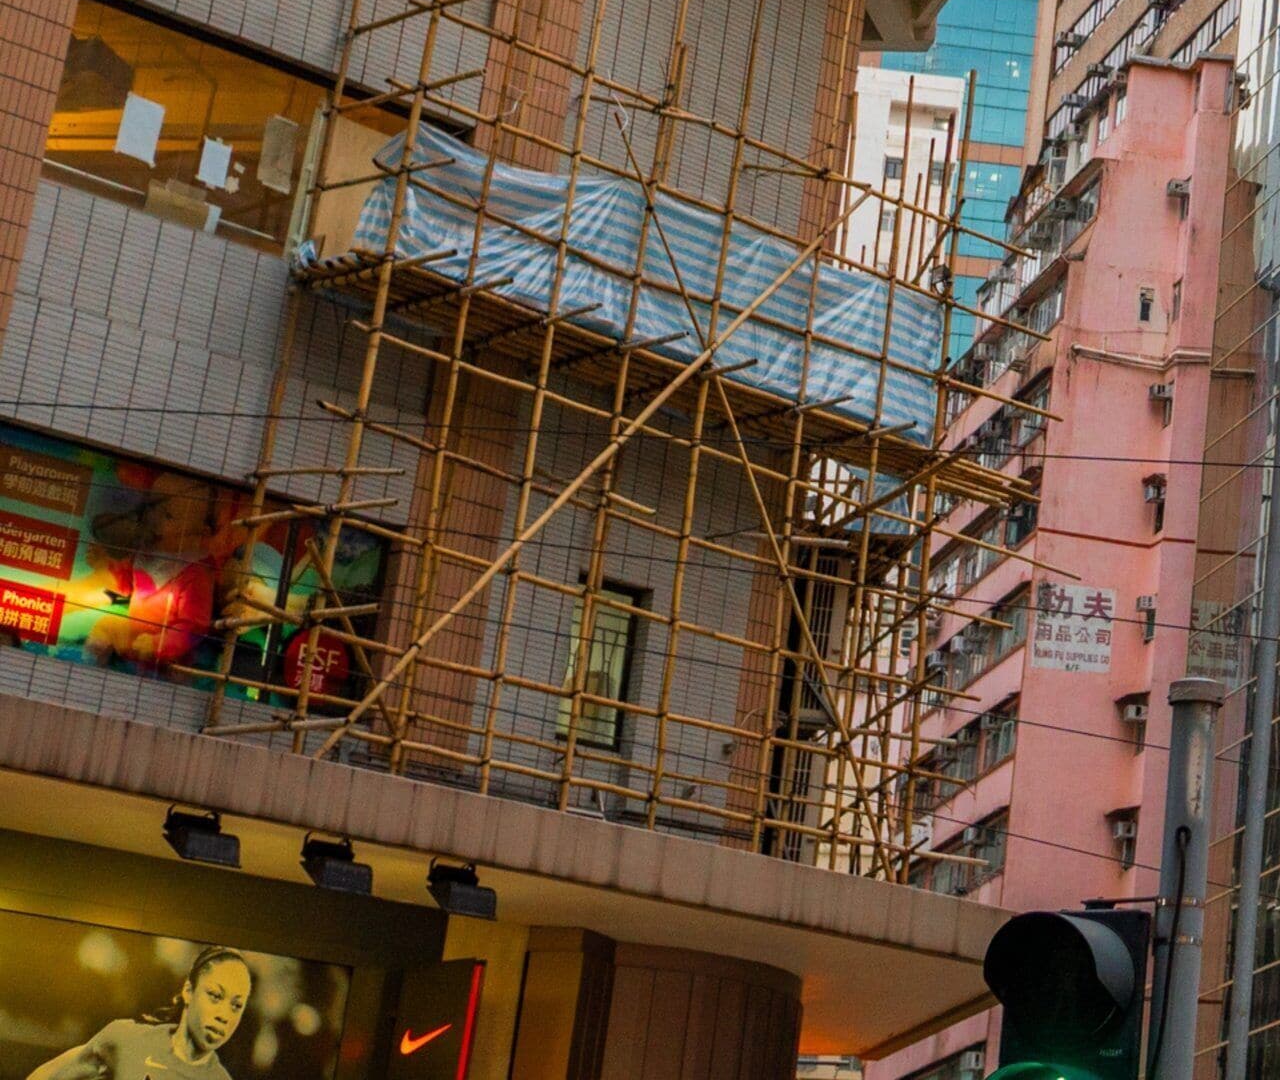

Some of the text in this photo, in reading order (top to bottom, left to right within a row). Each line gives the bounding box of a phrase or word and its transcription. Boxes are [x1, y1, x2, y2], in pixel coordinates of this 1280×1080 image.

[2, 589, 52, 614] Phonics
[1035, 623, 1112, 646] 用品公司
